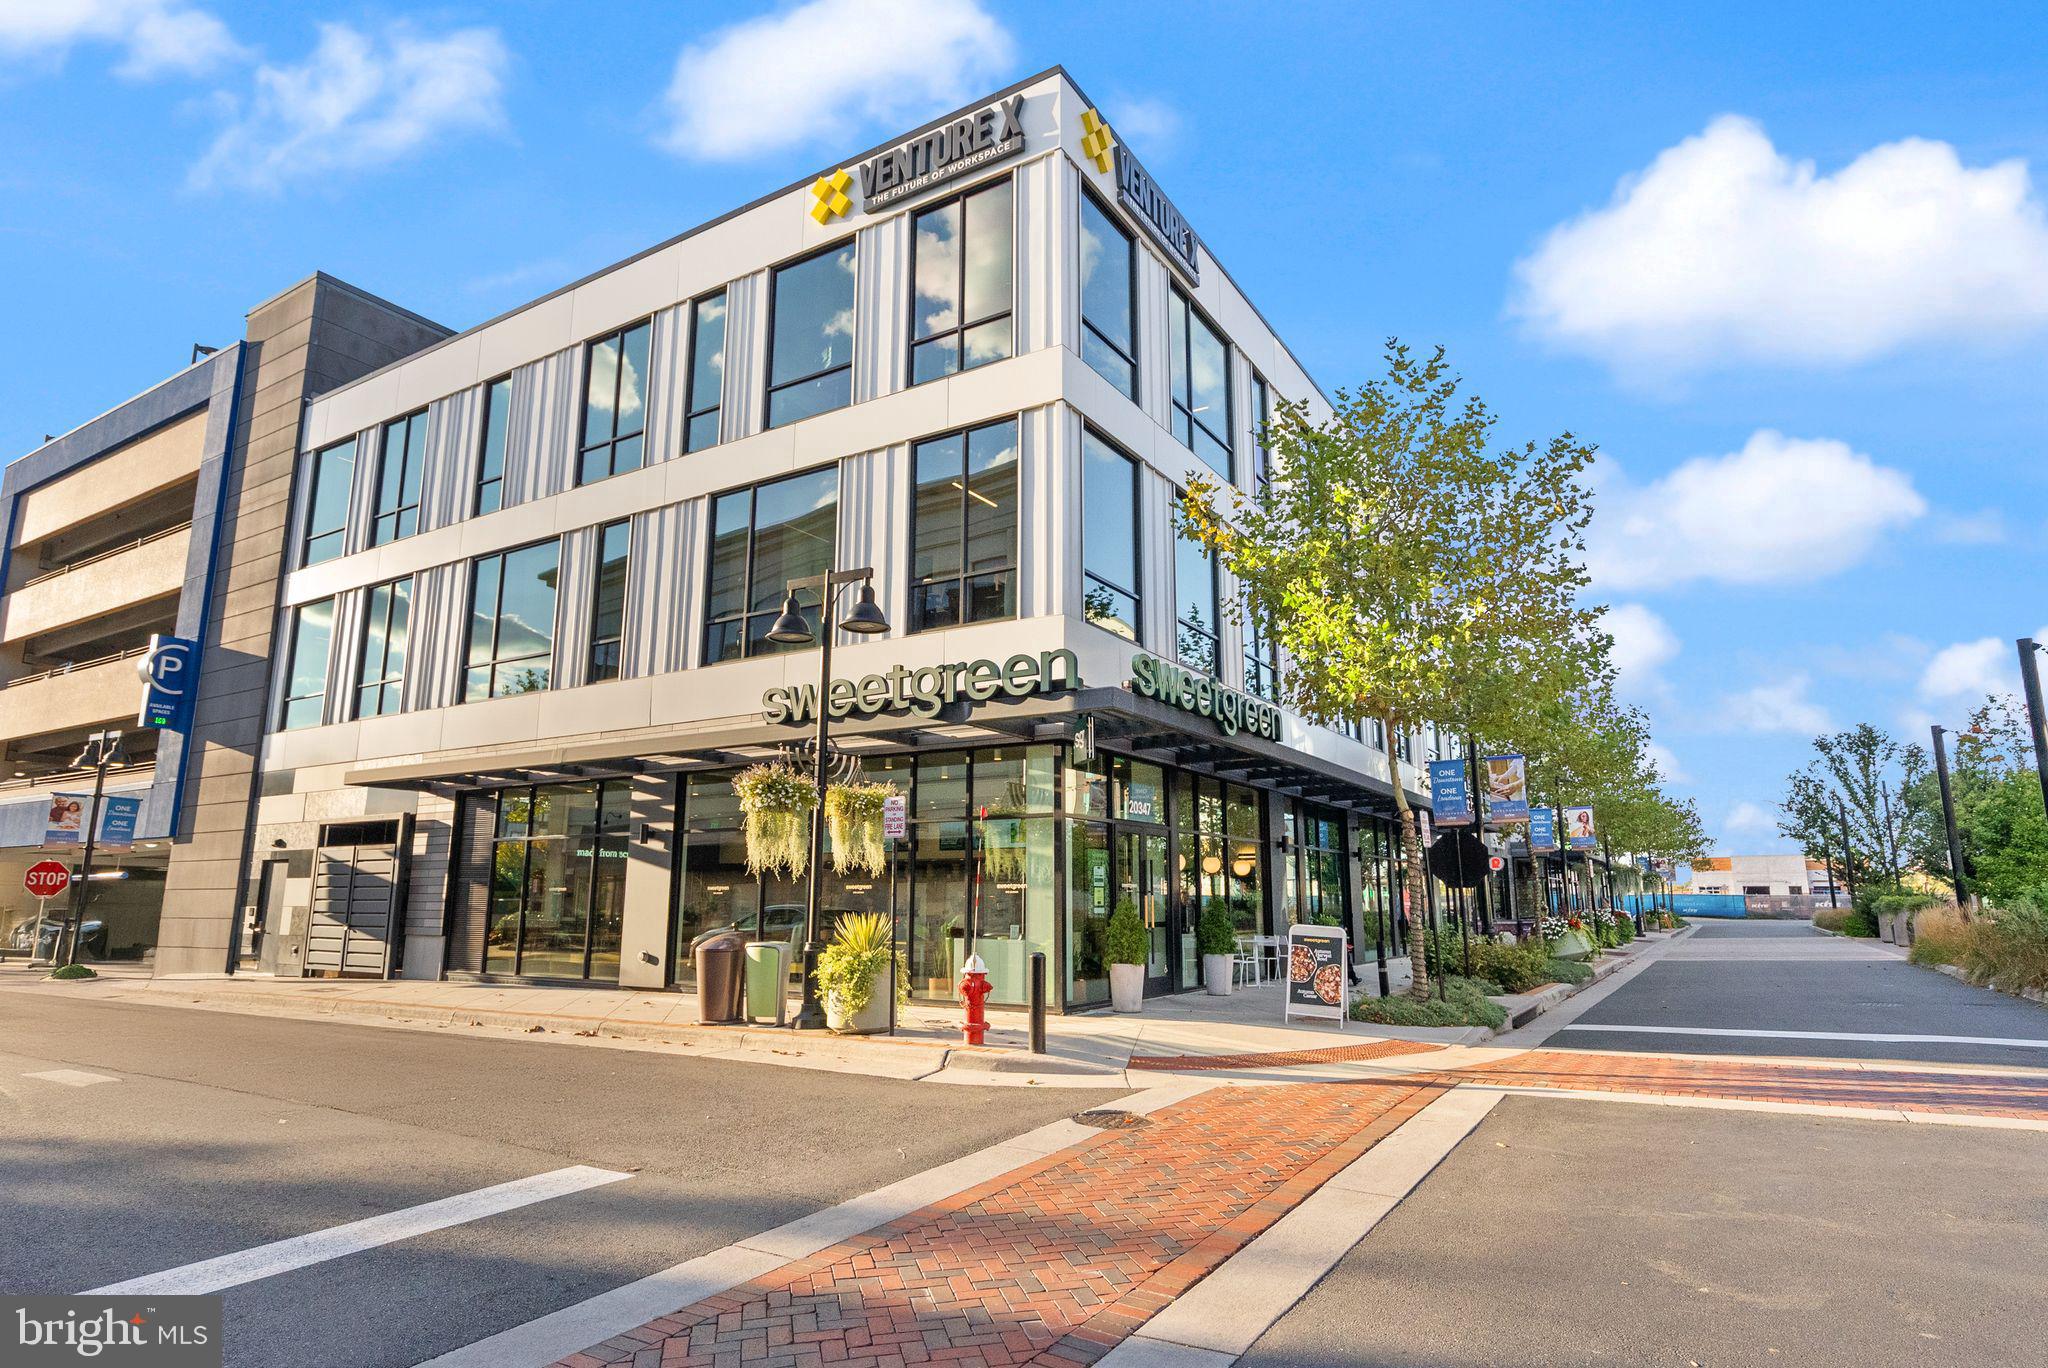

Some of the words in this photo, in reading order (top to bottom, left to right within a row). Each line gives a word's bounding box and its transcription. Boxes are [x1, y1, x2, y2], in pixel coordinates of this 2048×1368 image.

[859, 108, 996, 199] VENTURE
[1000, 93, 1025, 142] X
[872, 193, 890, 205] THE
[892, 178, 929, 197] FUTURE
[931, 169, 945, 181] OF
[948, 141, 1010, 174] WORKSPACE
[1113, 146, 1188, 260] VENTURE
[158, 655, 183, 680] P
[762, 648, 1080, 724] sweetgreen
[1132, 653, 1284, 742] sweetgreen
[1439, 769, 1456, 777] ONE
[1129, 800, 1151, 815] 20347
[599, 848, 617, 858] from
[27, 872, 67, 886] STOP
